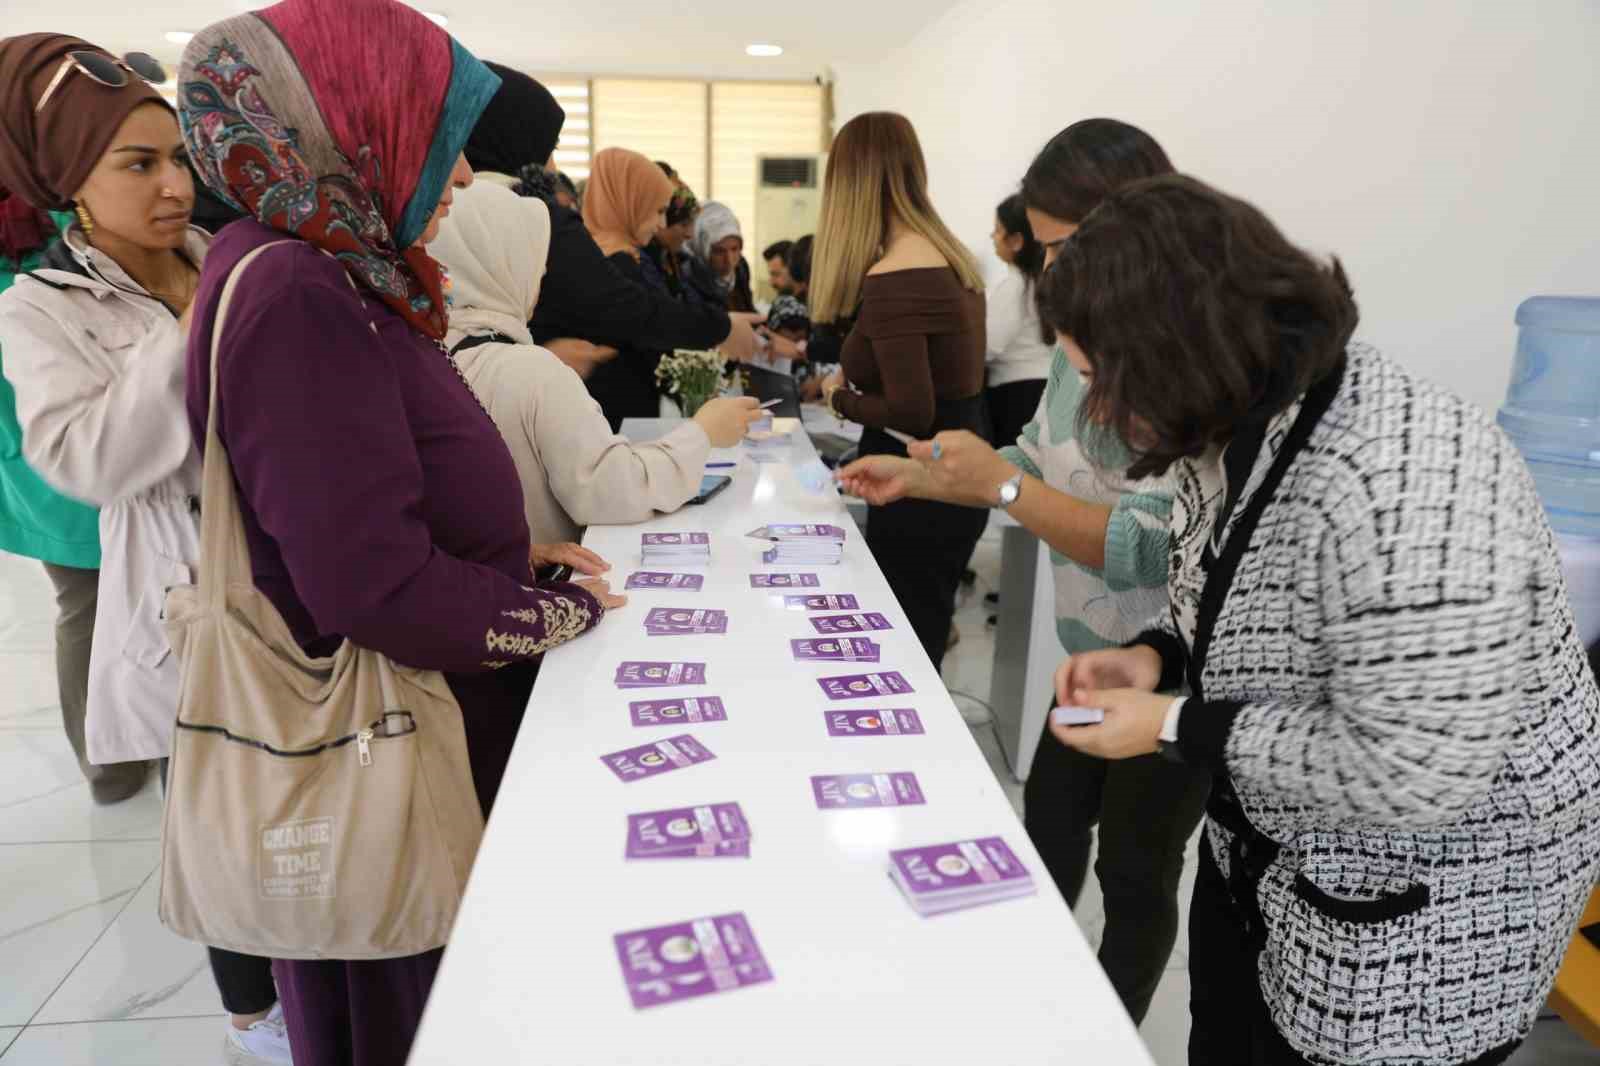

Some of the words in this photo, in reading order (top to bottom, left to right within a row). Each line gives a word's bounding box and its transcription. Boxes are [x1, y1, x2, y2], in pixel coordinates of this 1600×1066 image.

[832, 712, 855, 734] JIN
[263, 823, 329, 849] CHANGE
[637, 817, 668, 846] JIN
[273, 852, 321, 875] TIME
[902, 854, 943, 886] JIN
